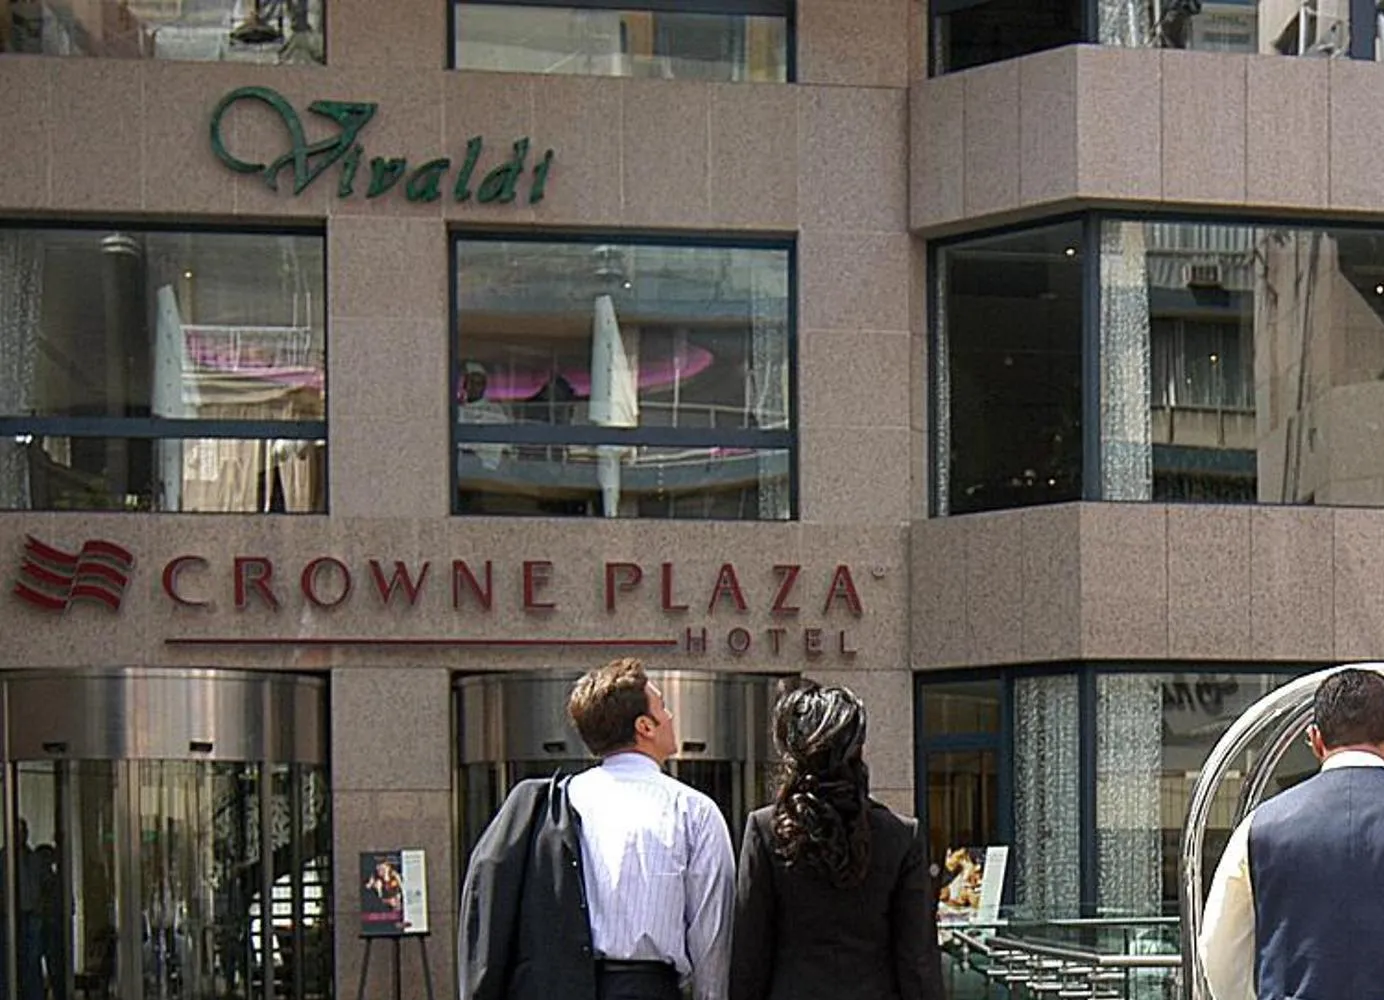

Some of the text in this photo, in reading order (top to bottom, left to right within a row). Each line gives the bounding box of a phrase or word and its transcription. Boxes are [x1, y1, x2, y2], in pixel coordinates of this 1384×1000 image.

[210, 86, 553, 203] Vivaldi
[162, 555, 863, 616] CROWNE PLAZA
[685, 627, 857, 656] HOTEL
